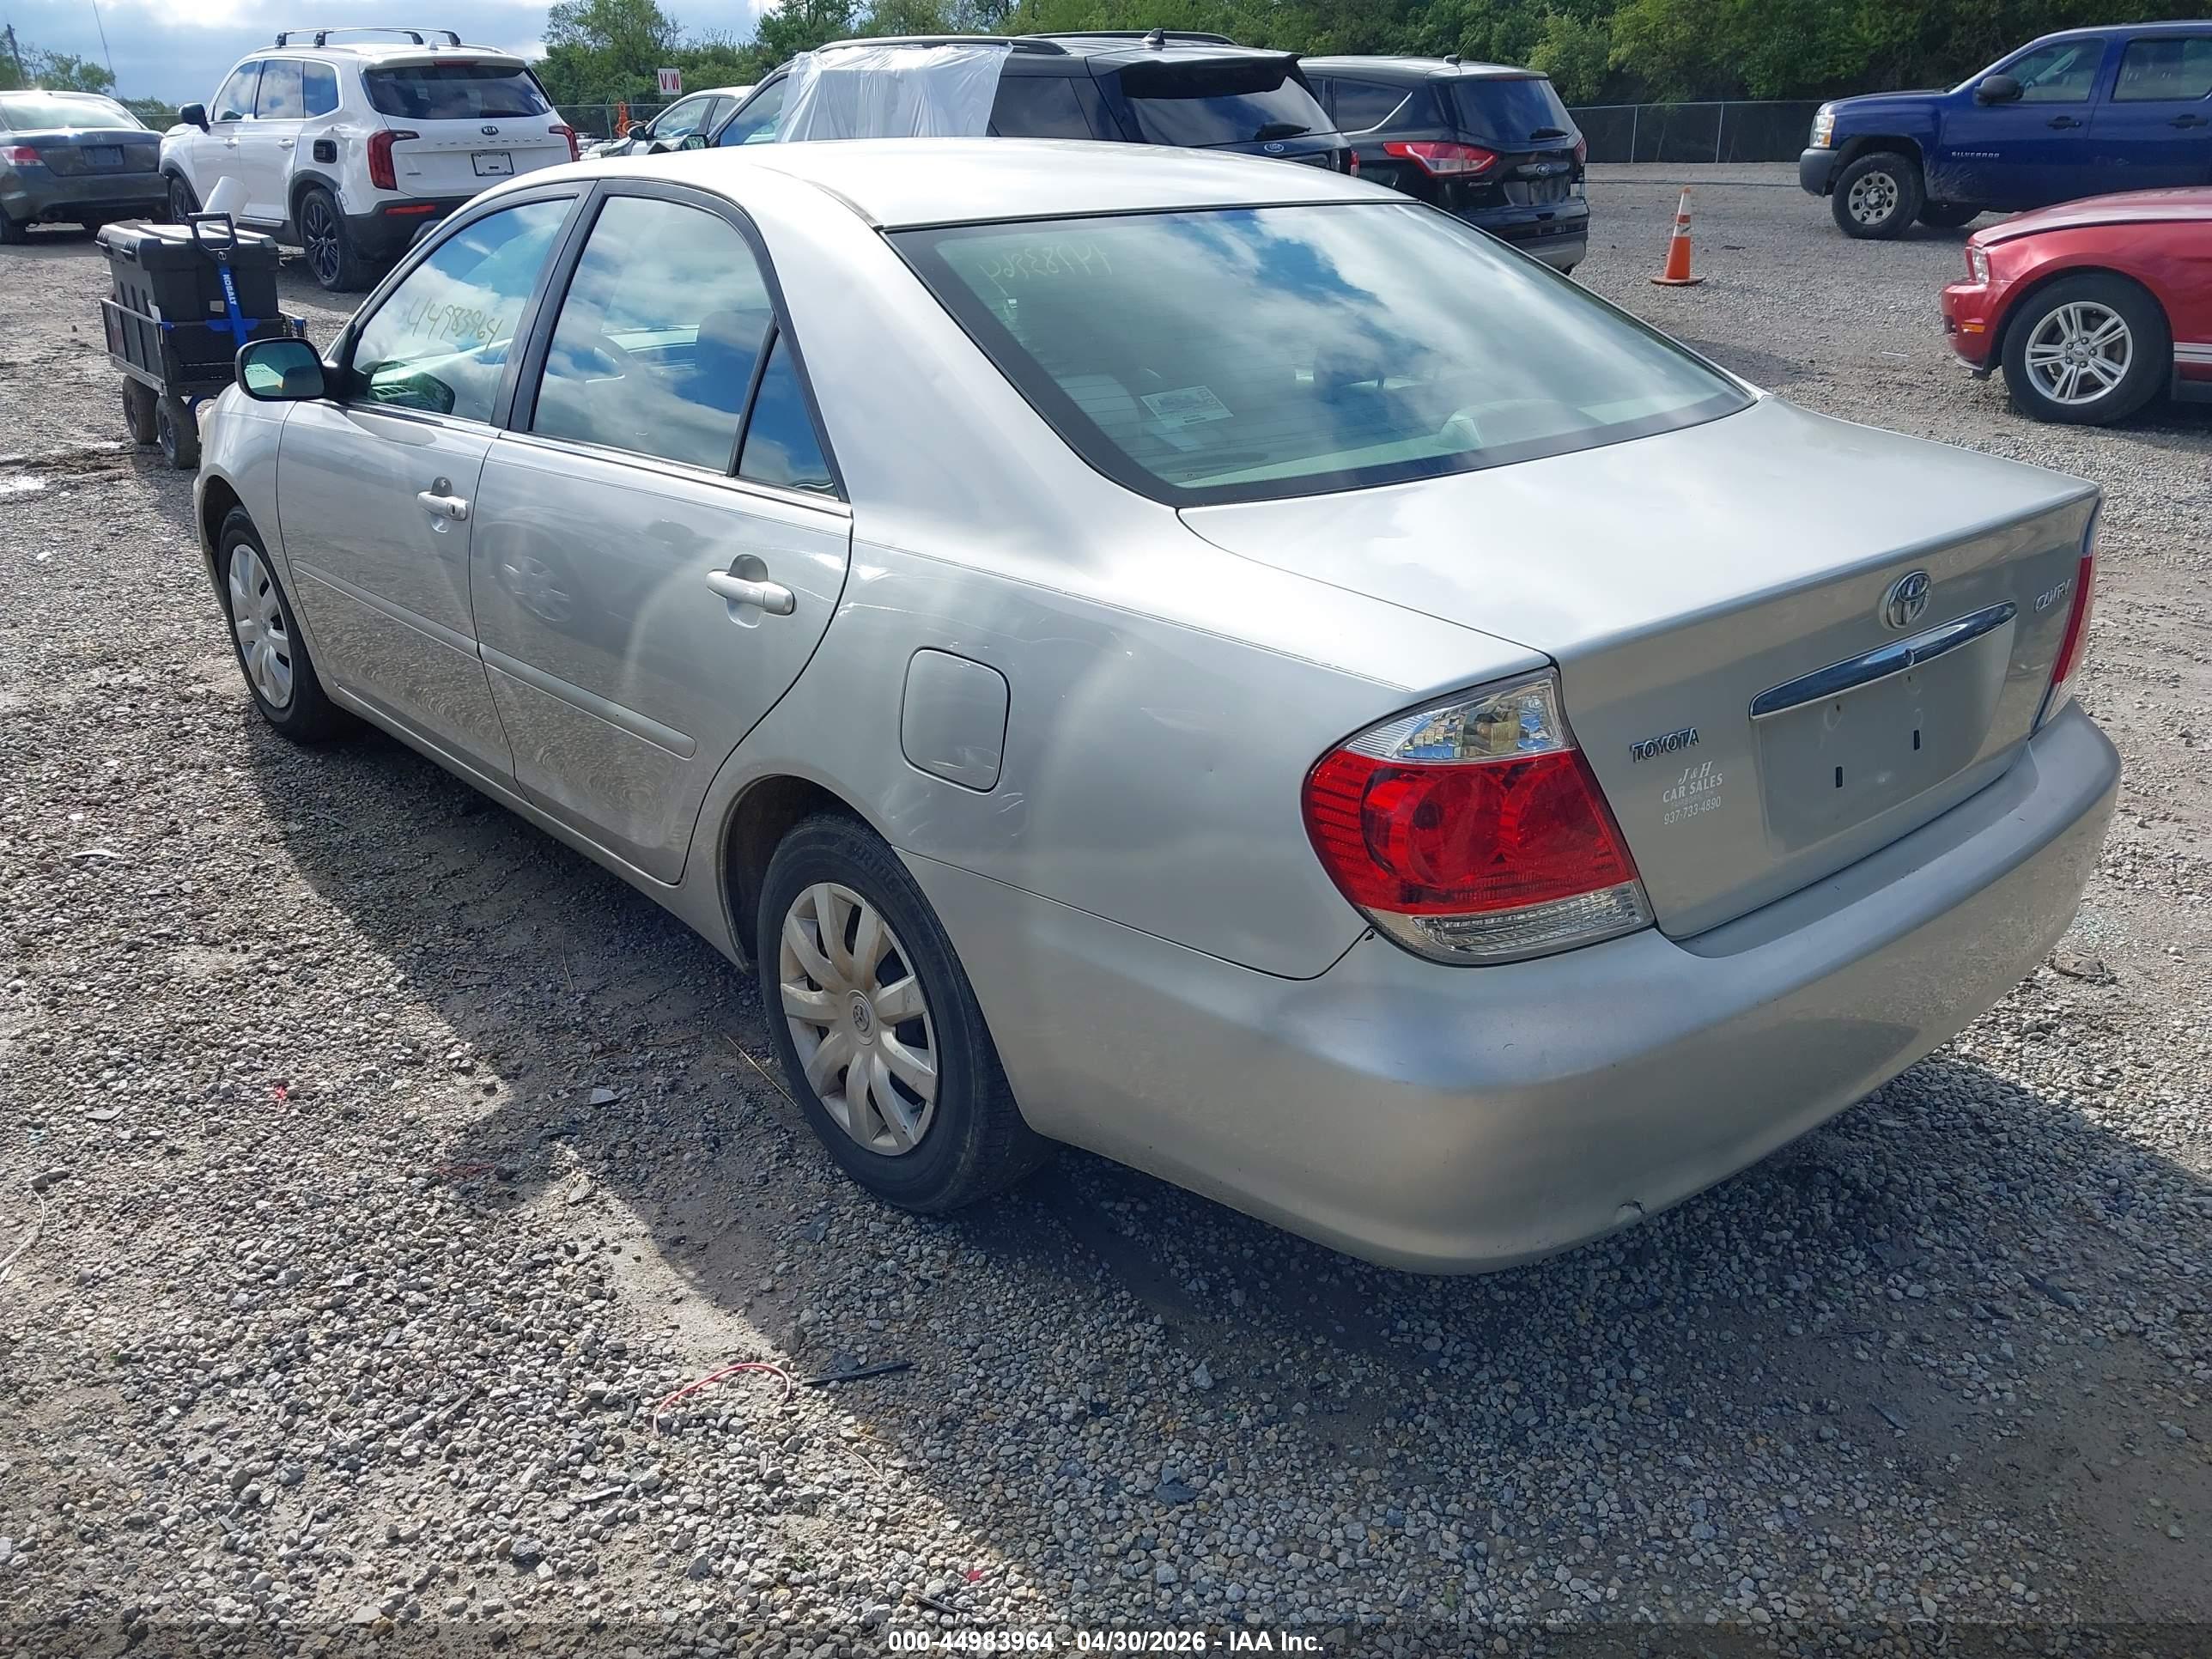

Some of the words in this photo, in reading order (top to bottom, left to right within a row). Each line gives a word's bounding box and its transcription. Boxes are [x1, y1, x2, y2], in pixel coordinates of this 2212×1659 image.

[483, 126, 497, 135] KIA
[222, 274, 237, 305] KOBALT
[407, 296, 503, 351] 44983964
[1630, 726, 1700, 763] TOYOTA
[1662, 785, 1686, 803] CAR
[1689, 773, 1723, 795] SALES
[1678, 768, 1691, 785] J
[1690, 768, 1698, 779] &
[1699, 761, 1713, 778] H
[1664, 795, 1722, 825] 937-733-4890
